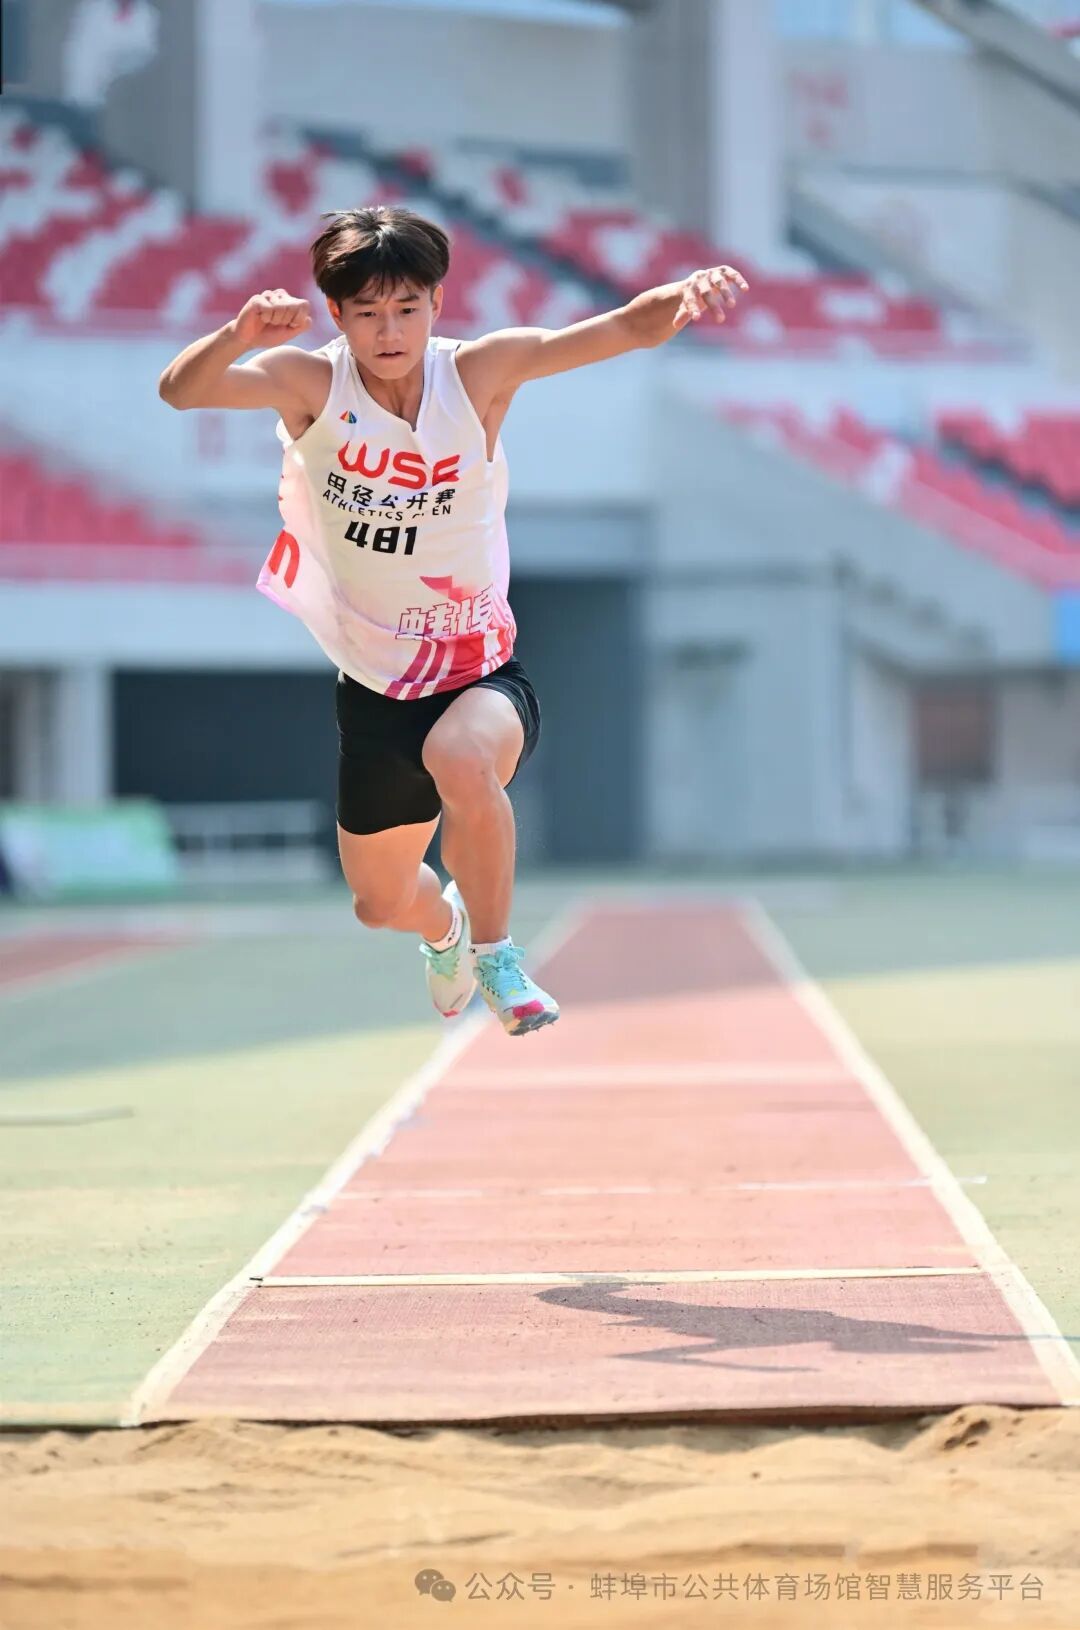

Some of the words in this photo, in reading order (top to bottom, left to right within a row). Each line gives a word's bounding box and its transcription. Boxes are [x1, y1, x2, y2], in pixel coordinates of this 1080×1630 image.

[322, 489, 404, 521] ATHLETICS
[327, 471, 456, 510] 田径公开赛
[344, 520, 417, 555] 481
